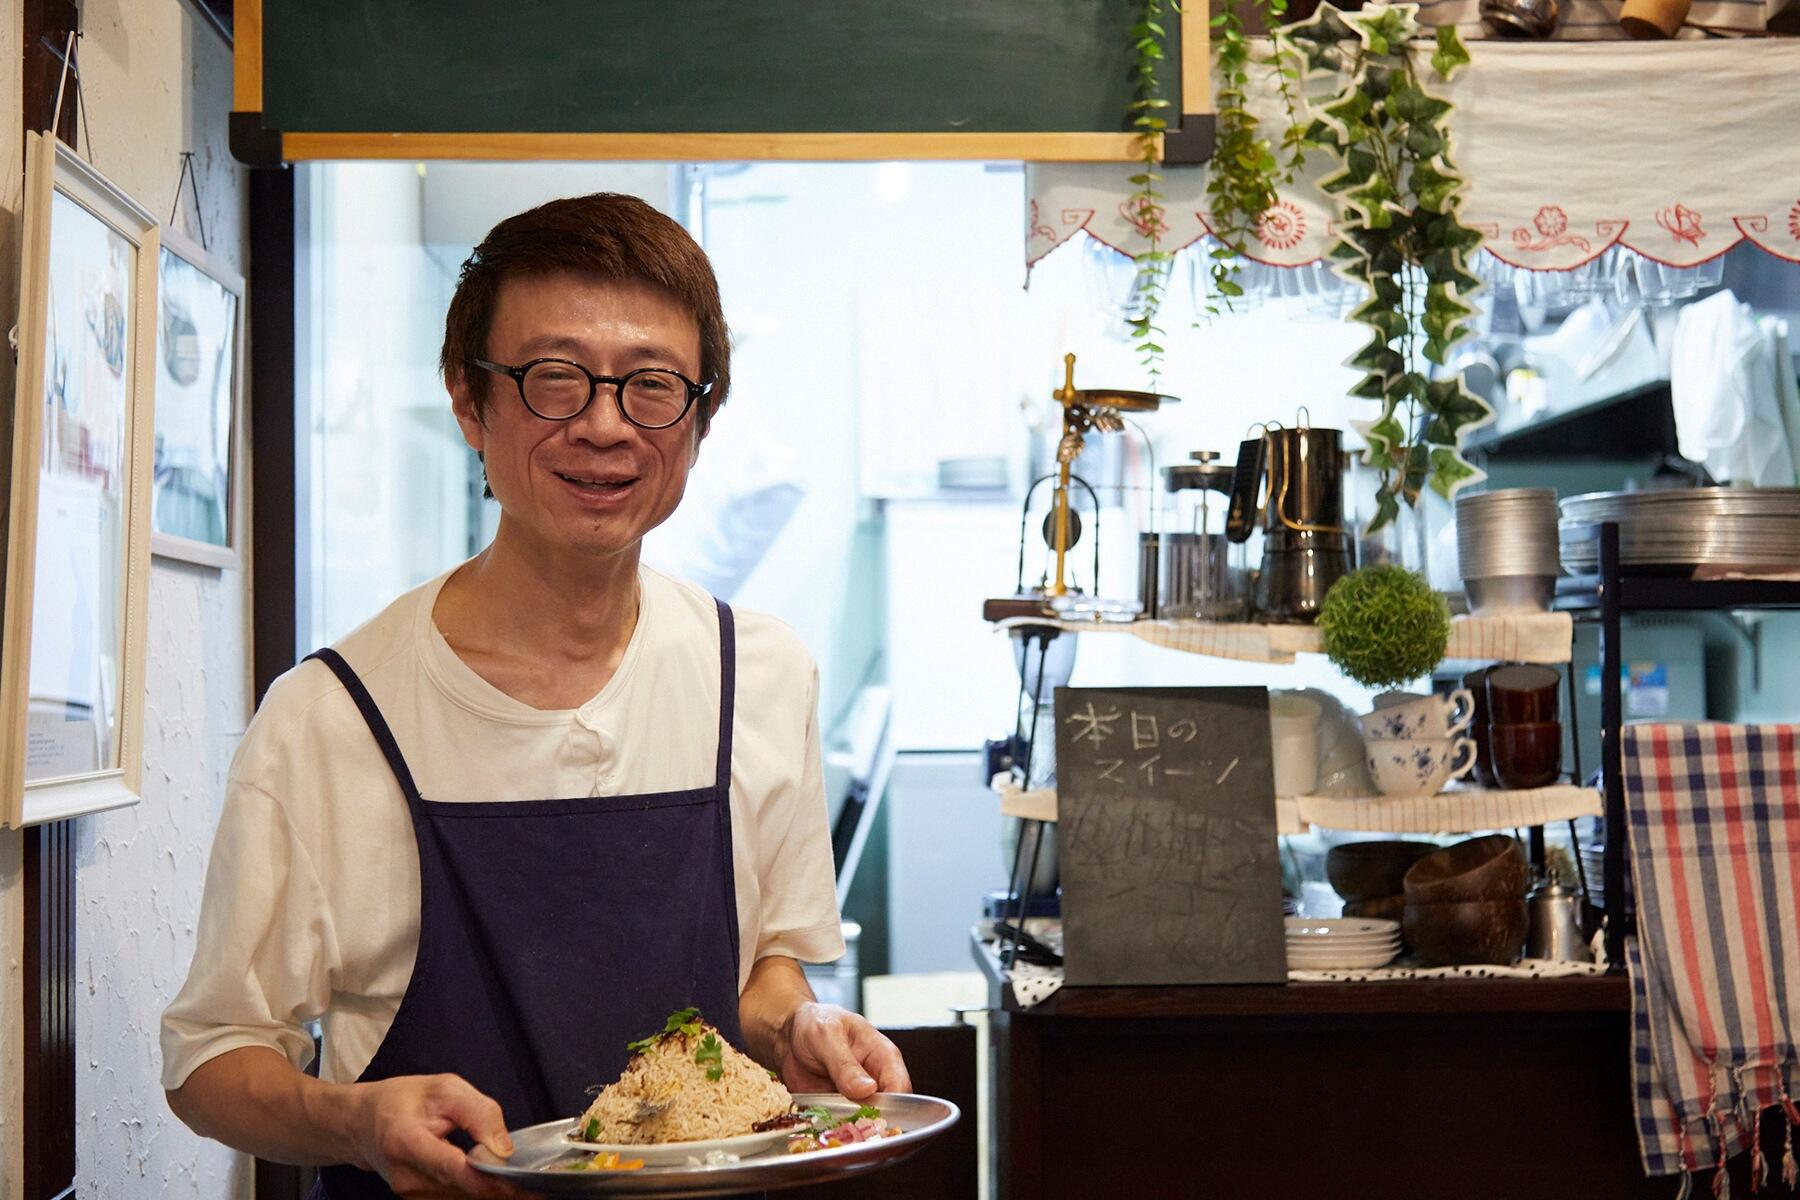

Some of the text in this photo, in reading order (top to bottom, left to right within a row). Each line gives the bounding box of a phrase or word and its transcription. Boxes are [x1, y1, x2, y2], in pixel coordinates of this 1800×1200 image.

[1065, 702, 1198, 750] 本日の
[1094, 753, 1239, 785] スイーツ
